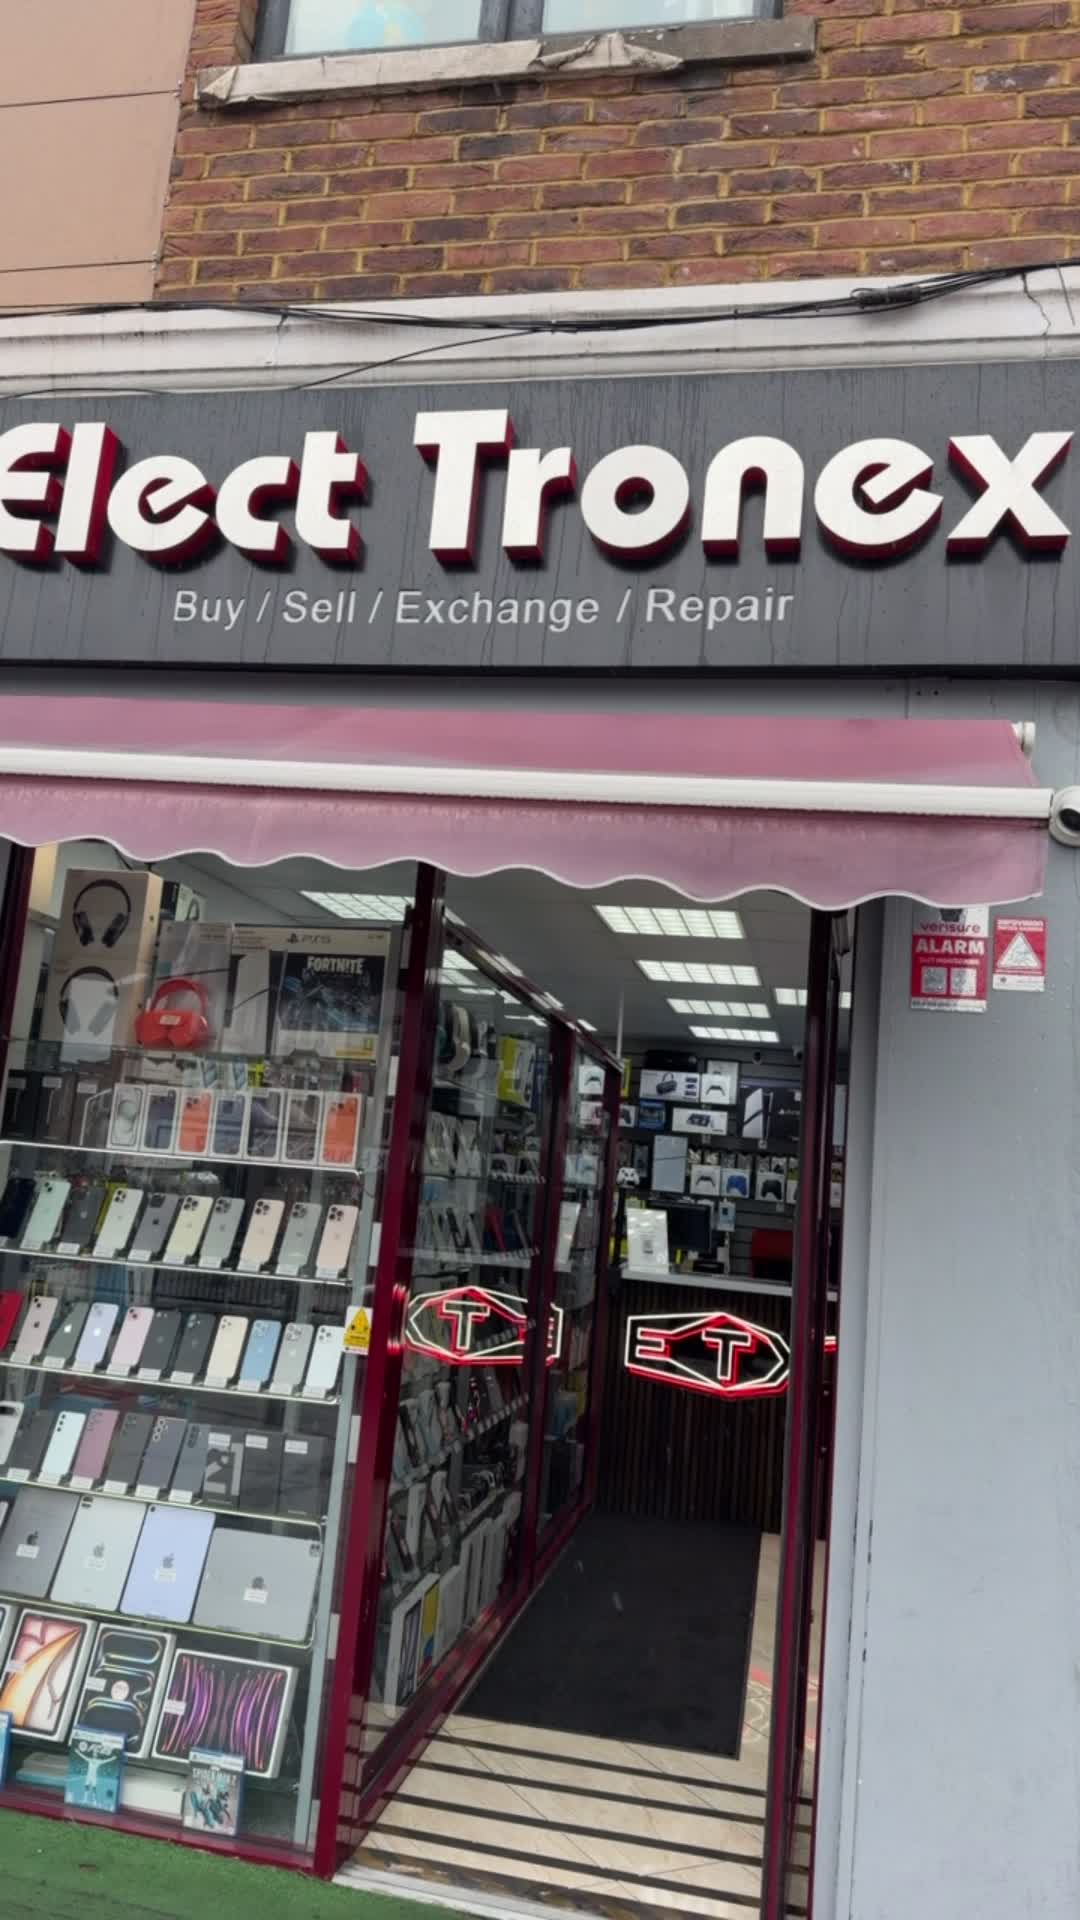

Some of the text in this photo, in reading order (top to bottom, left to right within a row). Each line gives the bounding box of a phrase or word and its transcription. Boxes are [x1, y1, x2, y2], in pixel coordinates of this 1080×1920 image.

[0, 409, 1075, 568] Elect Tronex
[173, 590, 244, 631] Buy
[282, 590, 356, 624] Sell
[395, 590, 599, 632] Exchange
[645, 587, 795, 630] Repair
[919, 920, 981, 934] verisure
[915, 938, 985, 955] ALARM
[306, 955, 365, 975] FORTNITE
